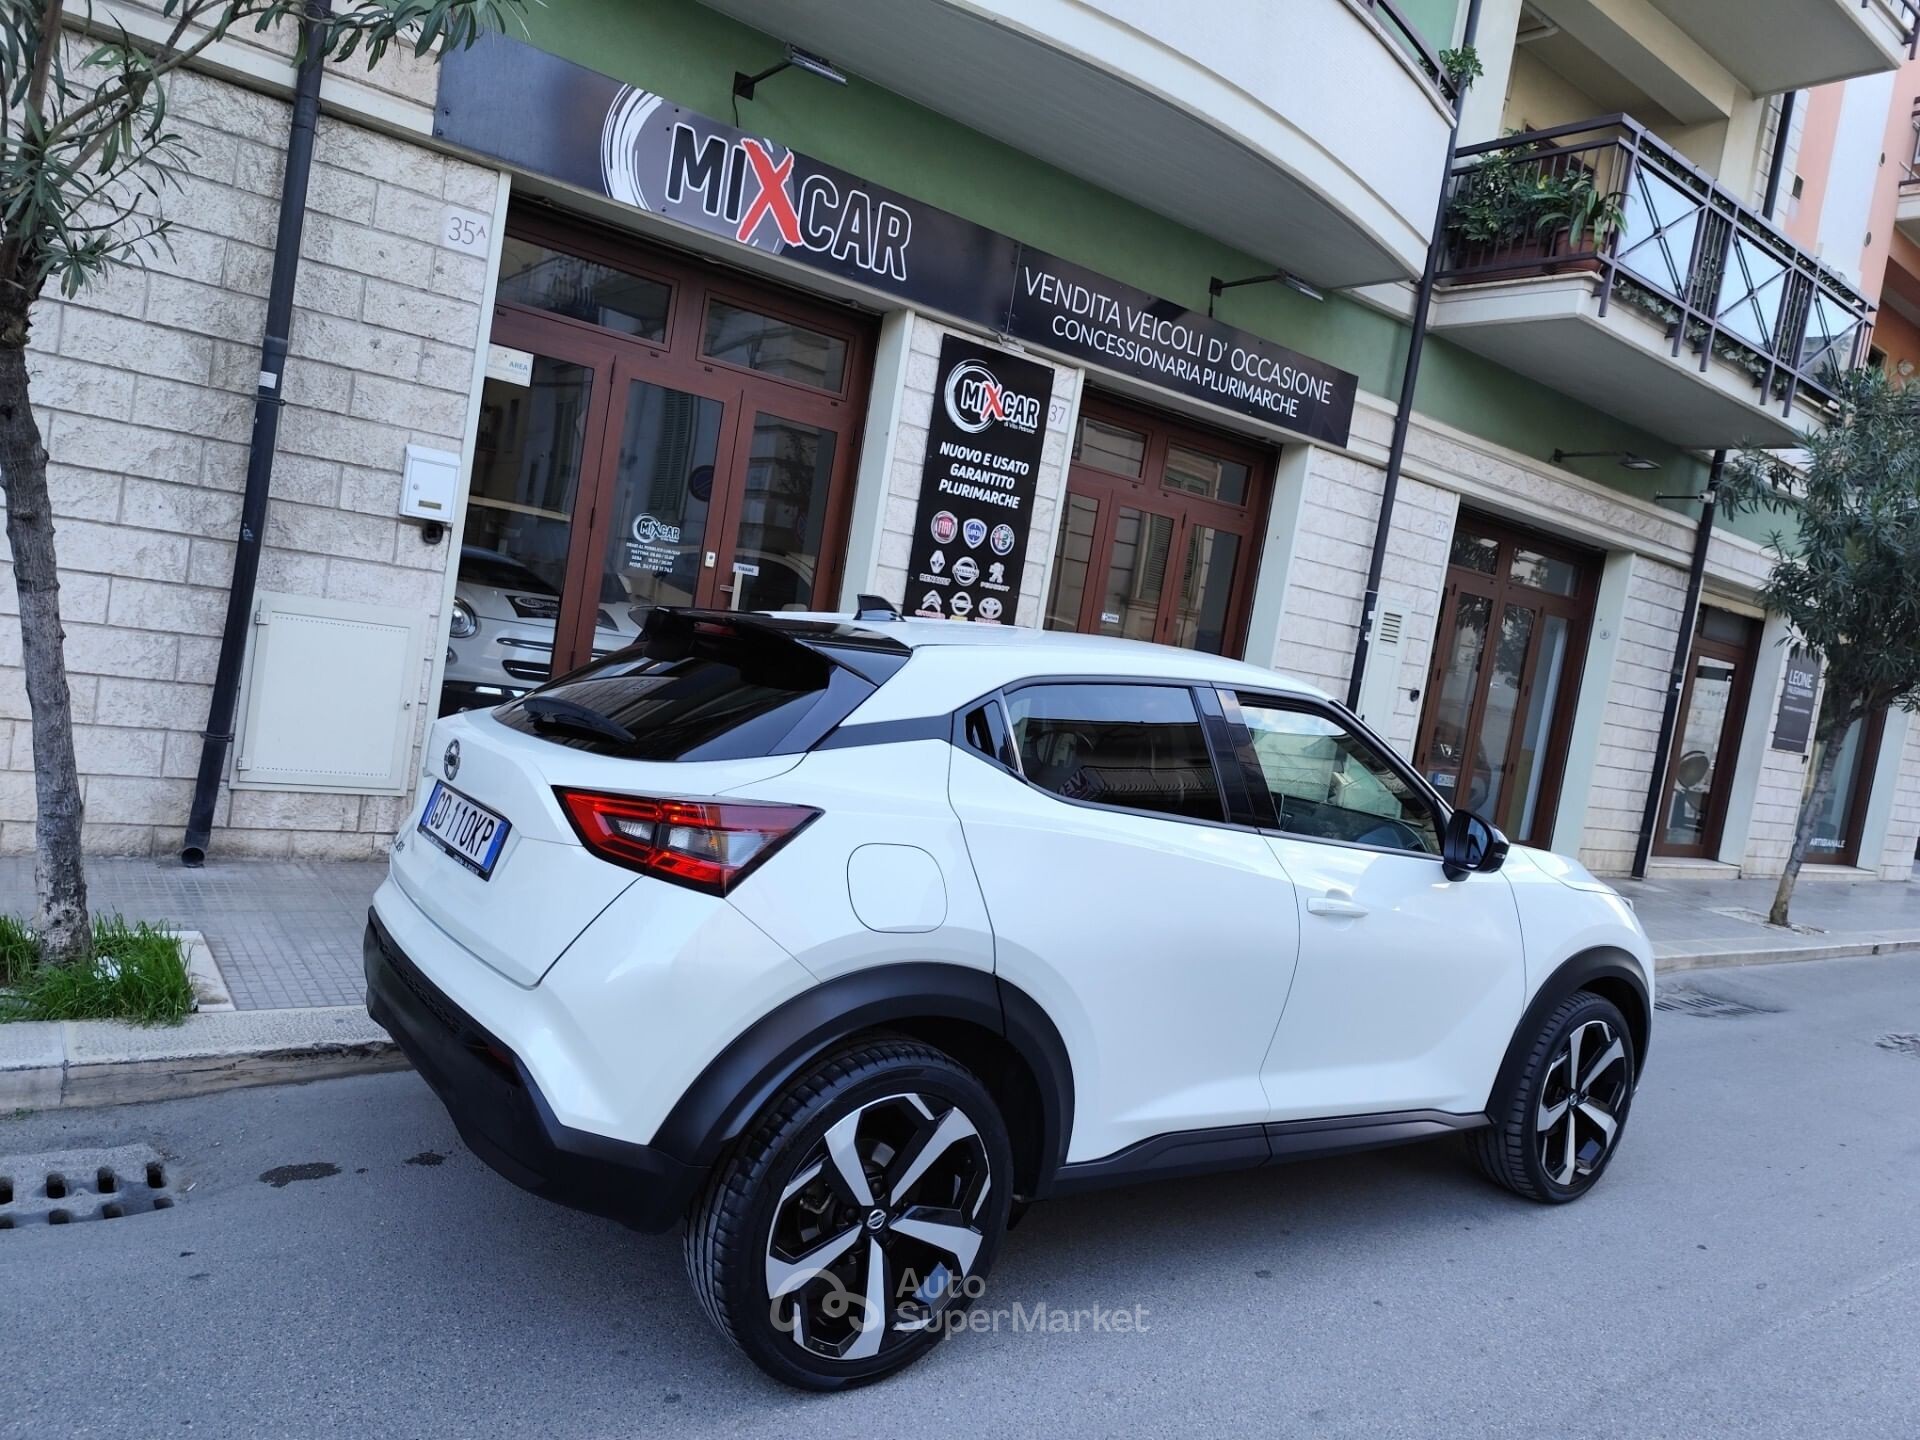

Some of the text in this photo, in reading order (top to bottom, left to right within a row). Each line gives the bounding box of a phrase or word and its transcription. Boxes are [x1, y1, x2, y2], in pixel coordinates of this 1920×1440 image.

[664, 121, 912, 282] MIXCAR
[1025, 266, 1335, 405] VENDITA VEICOLI D' OCCASIONE
[508, 361, 528, 371] AREA
[1052, 315, 1300, 418] CONCESSIONARIA PLURIMARCHE
[960, 379, 1040, 428] MIXCAR
[1049, 406, 1066, 425] 37
[939, 441, 1030, 476] NUOVO E USATO
[950, 463, 1015, 490] GARANTITO
[938, 478, 1021, 509] PLURIMARCHE
[639, 520, 681, 540] MIXCAR
[1788, 668, 1814, 688] LEONE
